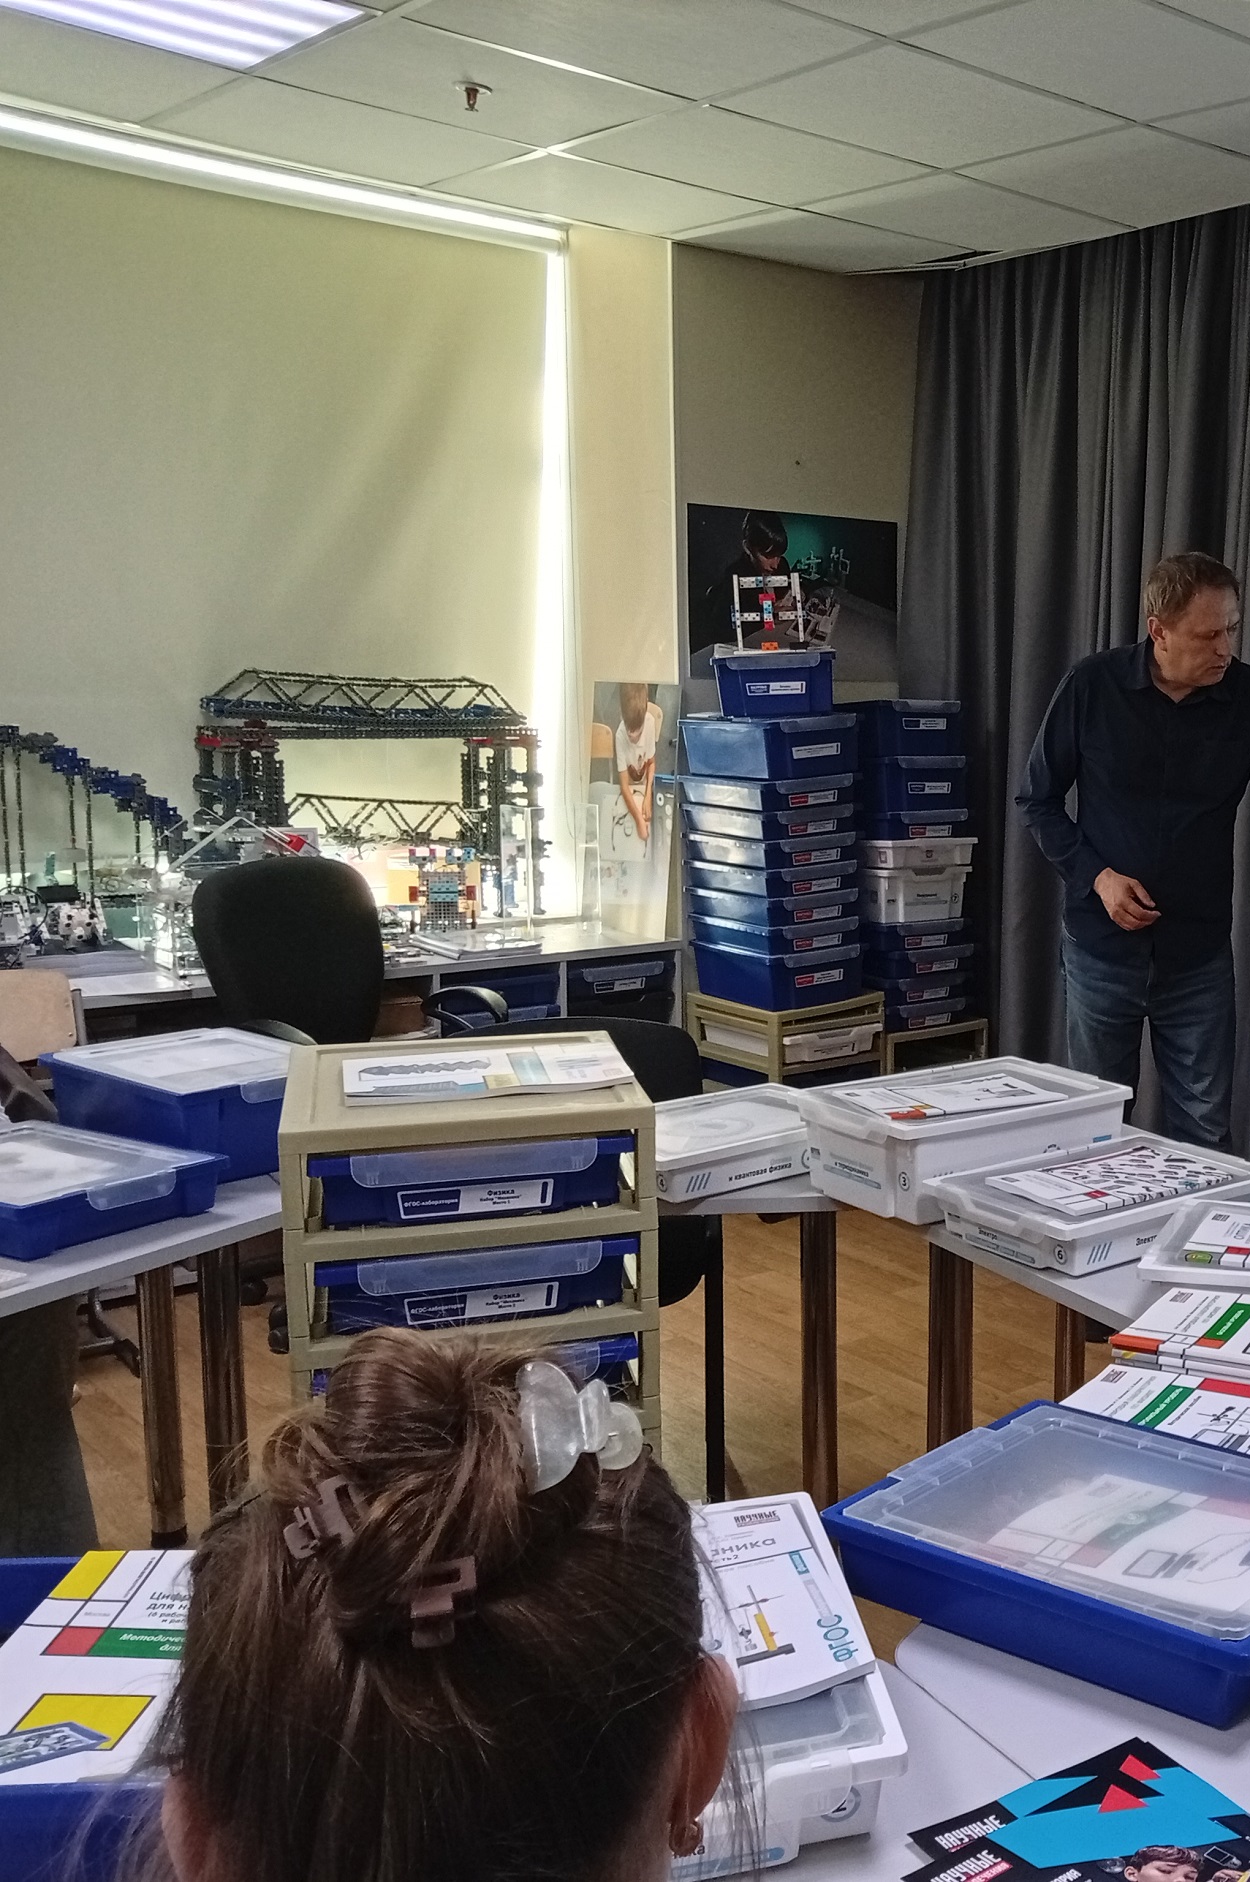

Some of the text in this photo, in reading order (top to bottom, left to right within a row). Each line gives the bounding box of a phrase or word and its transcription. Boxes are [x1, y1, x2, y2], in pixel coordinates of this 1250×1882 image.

[734, 1168, 767, 1181] квантовая
[769, 1161, 792, 1174] физика
[487, 1189, 515, 1197] Физика
[145, 1603, 175, 1611] для
[816, 1614, 859, 1663] ФГОС
[159, 1643, 182, 1652] для
[934, 1815, 1007, 1850] НАУЧНЫЕ
